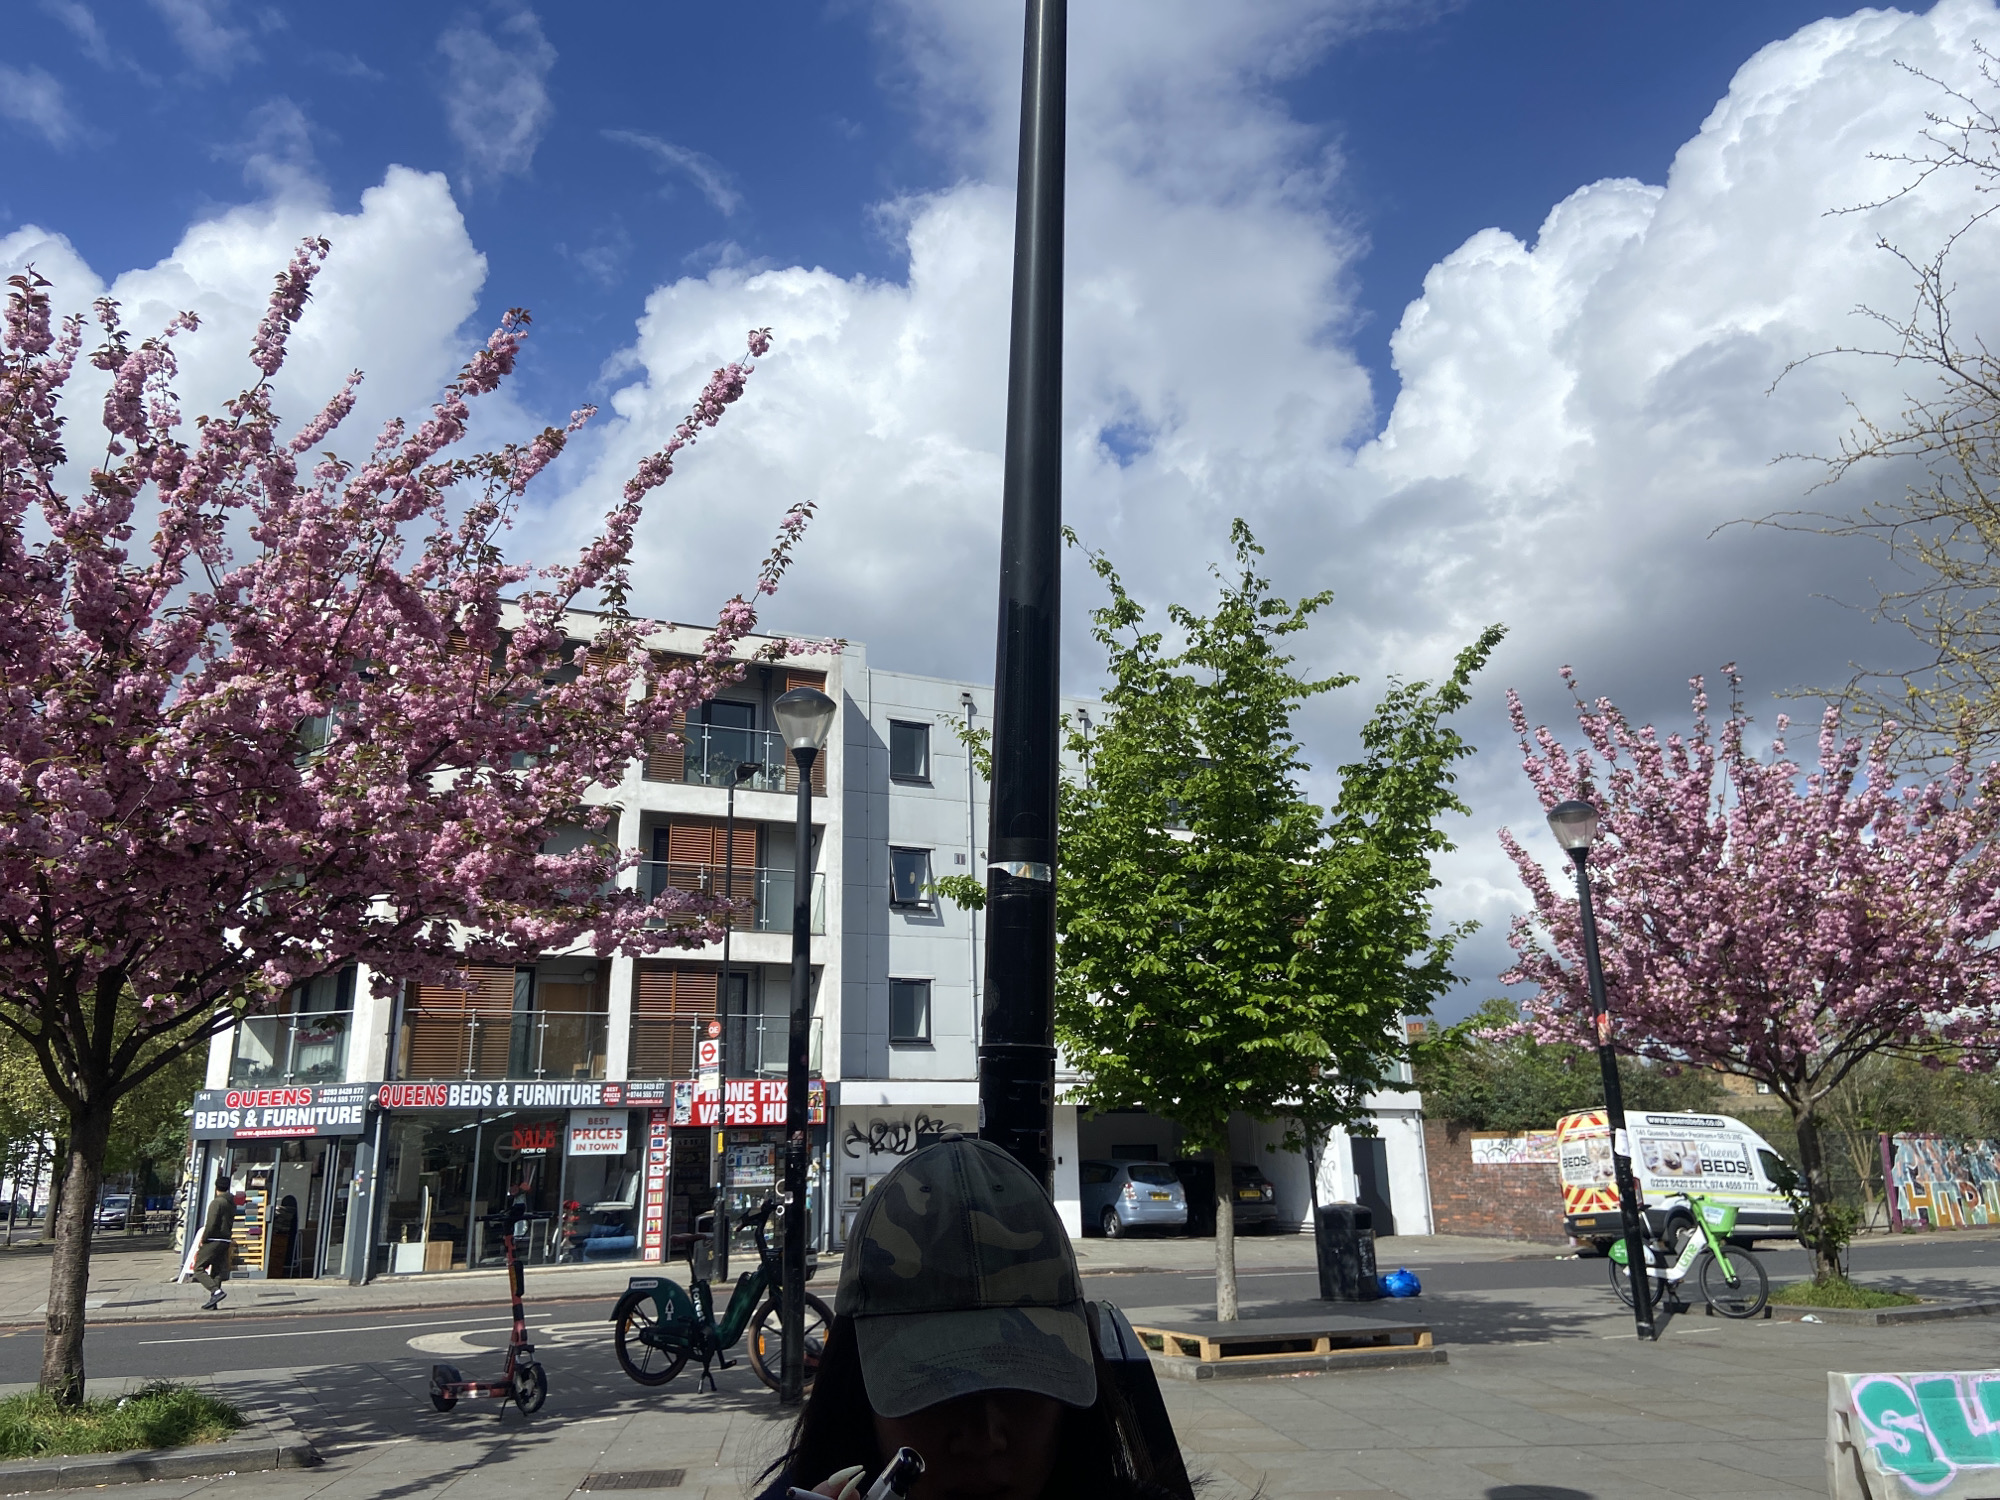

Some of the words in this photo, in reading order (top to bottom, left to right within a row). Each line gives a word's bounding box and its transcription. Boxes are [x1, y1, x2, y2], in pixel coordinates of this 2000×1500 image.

[708, 1026, 719, 1034] OE
[199, 1093, 211, 1101] 141
[225, 1088, 312, 1109] QUEENS
[378, 1084, 447, 1108] QUEENS
[449, 1084, 492, 1106] BEDS
[496, 1084, 509, 1106] &
[513, 1084, 601, 1106] FURNITURE
[195, 1110, 241, 1130] BEDS
[244, 1109, 258, 1128] &
[262, 1105, 363, 1127] FURNITURE
[587, 1117, 610, 1125] BEST
[698, 1103, 757, 1124] VAPES
[762, 1103, 788, 1123] HU
[236, 1127, 315, 1137] www.queensbeds.co.uk
[512, 1123, 557, 1149] SALE
[572, 1127, 623, 1140] PRICES
[576, 1143, 586, 1151] IN
[589, 1142, 618, 1151] TOWN
[1697, 1142, 1740, 1160] Queens
[1562, 1156, 1587, 1168] BEDS
[1701, 1159, 1748, 1174] BEDS
[692, 1287, 707, 1323] forest
